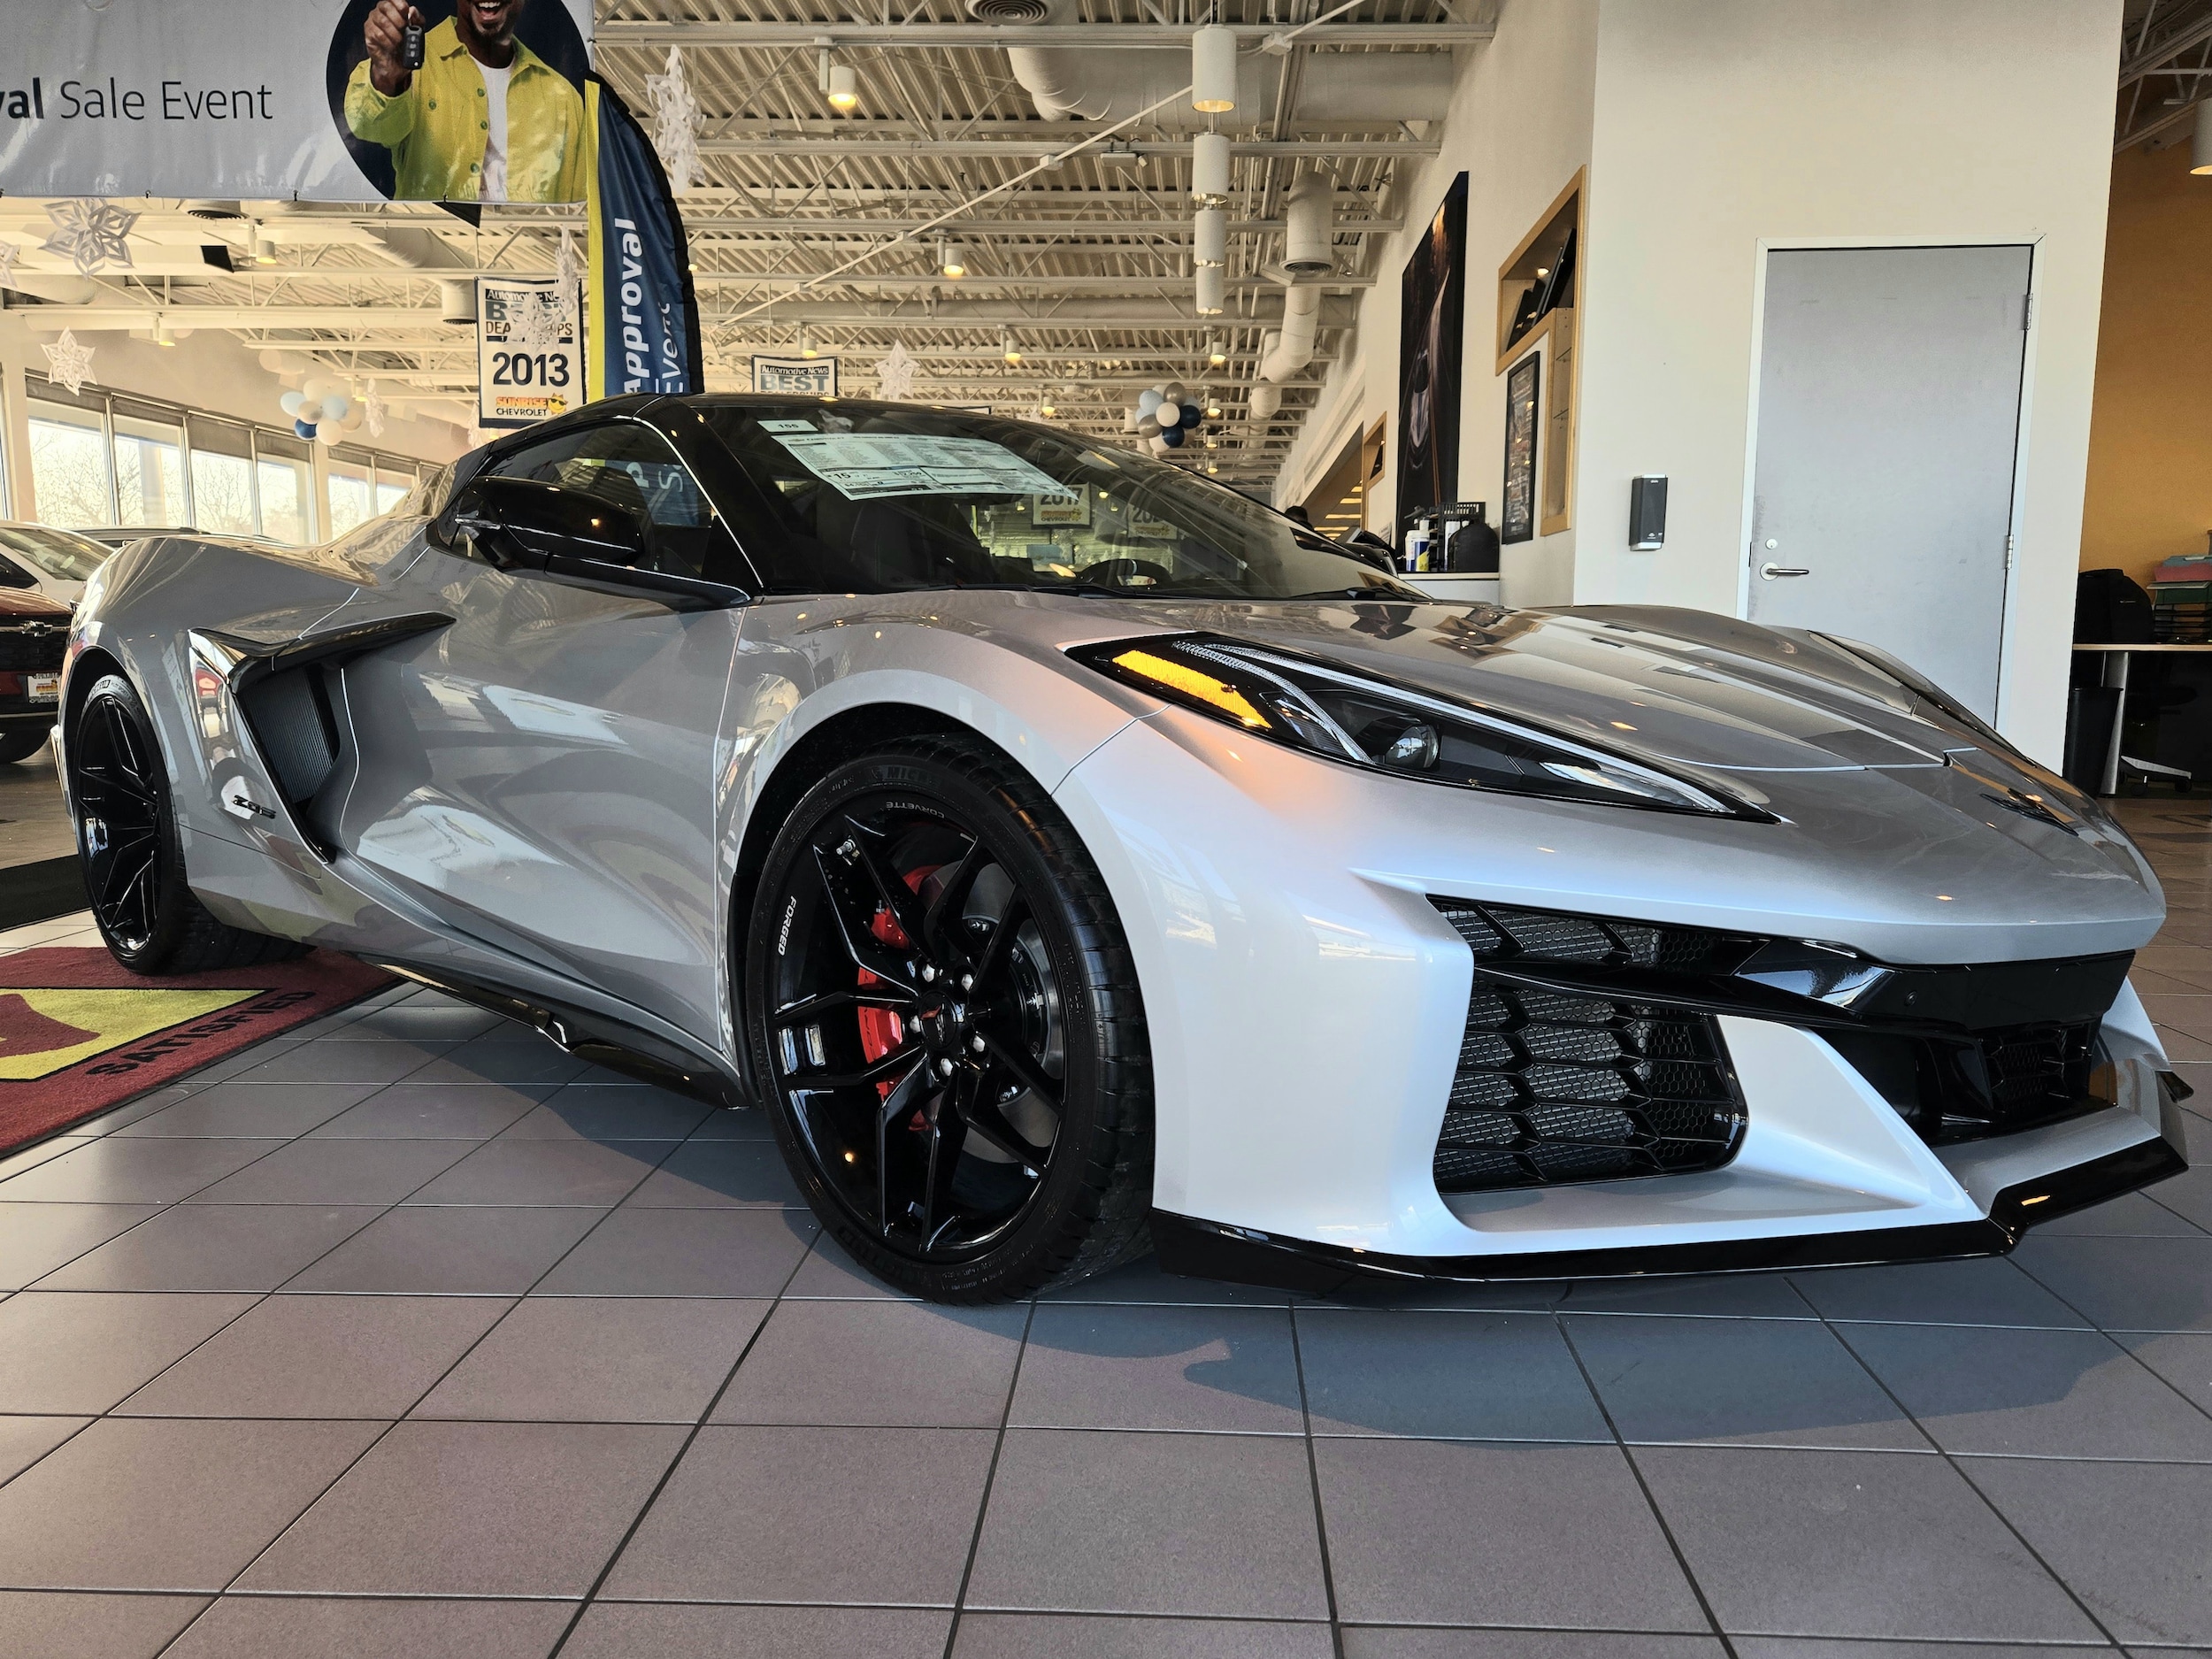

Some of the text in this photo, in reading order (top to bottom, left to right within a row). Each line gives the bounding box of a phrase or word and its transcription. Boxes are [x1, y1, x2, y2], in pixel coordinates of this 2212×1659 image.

[0, 77, 273, 120] al Sale Event
[614, 218, 650, 394] Approval
[492, 351, 570, 388] 2013
[761, 365, 829, 375] Automotive News
[761, 374, 829, 391] BEST
[496, 396, 549, 408] SUNRISE
[886, 801, 945, 818] CORVETTE
[778, 895, 797, 956] FORGED
[86, 991, 317, 1075] SATISFIED
